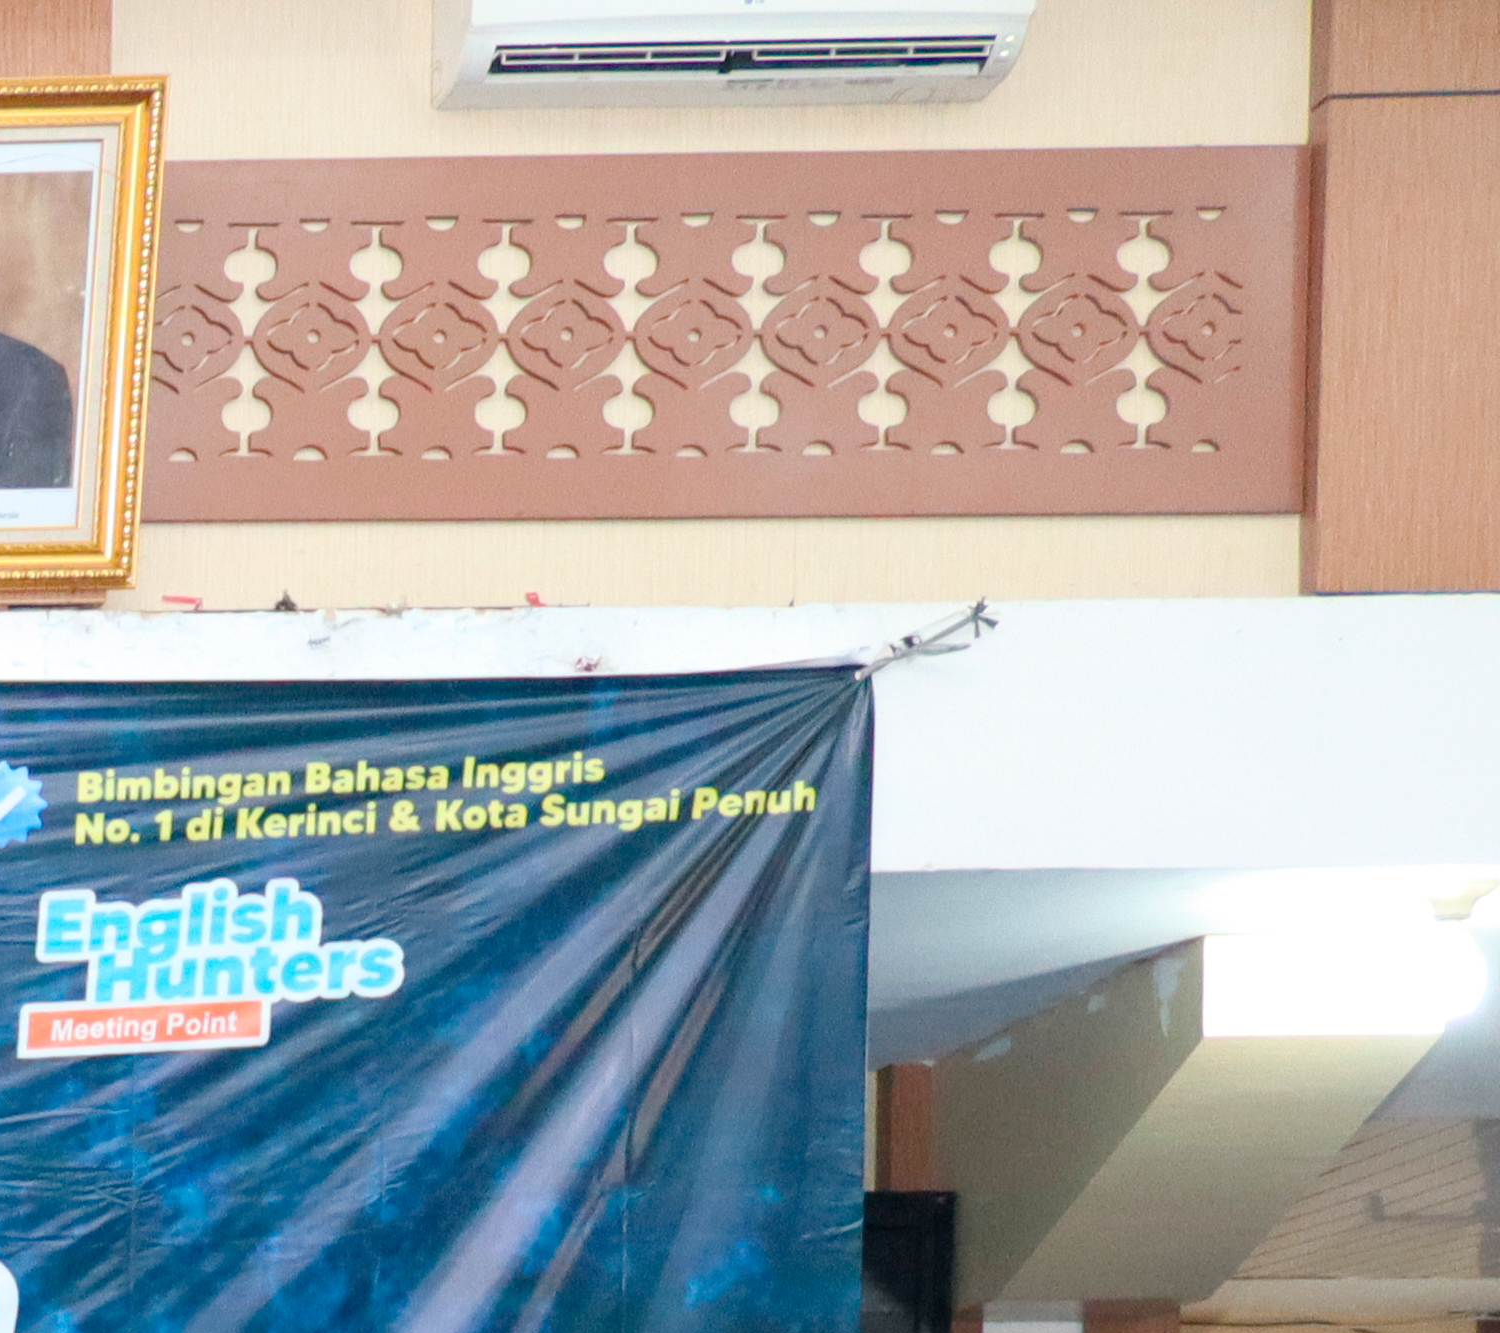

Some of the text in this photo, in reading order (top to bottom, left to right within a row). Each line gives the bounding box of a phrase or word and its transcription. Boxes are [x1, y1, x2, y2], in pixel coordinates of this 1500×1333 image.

[73, 780, 816, 846] No. 1 di Kerinci & Kota Sungai Penuh
[75, 752, 605, 810] Bimbingan Bahasa Inggris
[37, 878, 323, 965] English
[88, 936, 404, 1004] Hunters
[49, 1010, 239, 1046] Meeting Point
